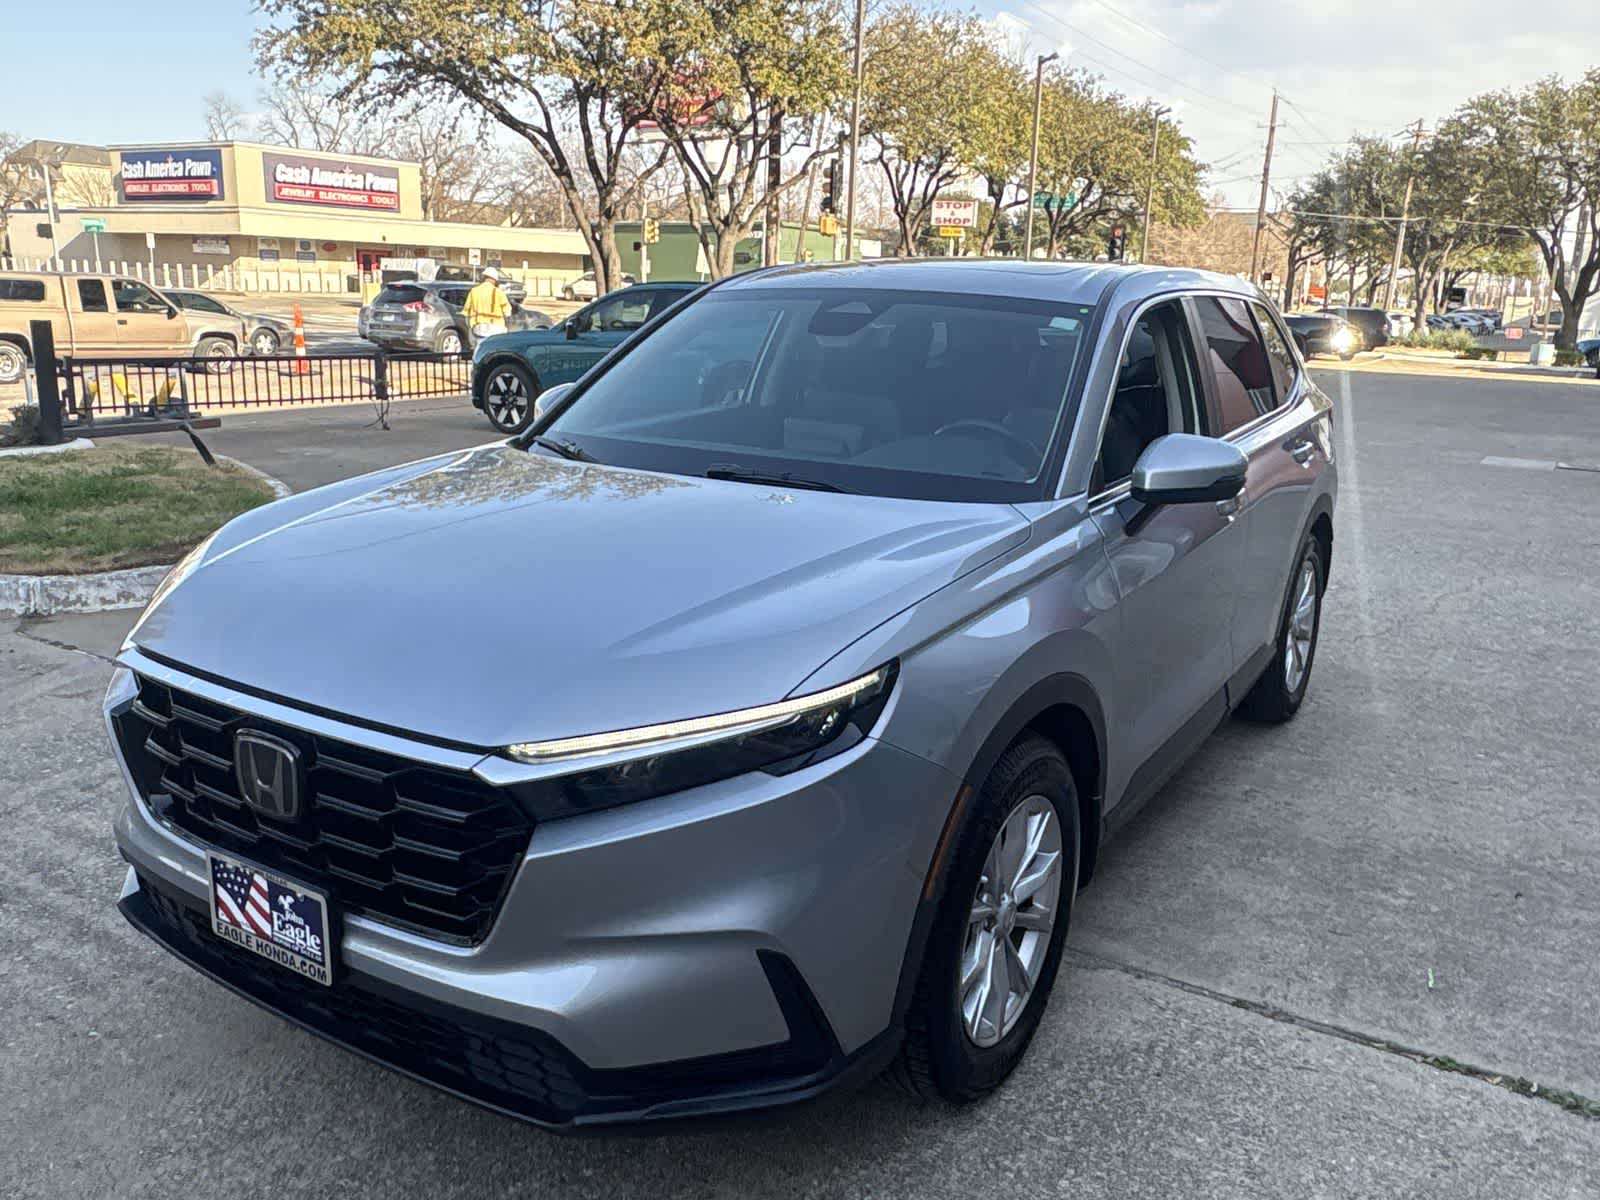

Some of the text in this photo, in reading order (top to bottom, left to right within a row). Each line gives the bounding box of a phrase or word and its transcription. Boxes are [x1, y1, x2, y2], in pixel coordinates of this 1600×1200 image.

[121, 158, 212, 178] Cash America Pawn
[275, 163, 398, 192] Cash America Pawn
[280, 187, 395, 205] JEWELRY ELECTRONICS TOOLS
[935, 201, 972, 209] STOP
[934, 217, 971, 225] SHOP
[284, 908, 304, 925] John
[271, 910, 321, 950] Eagle
[216, 921, 253, 949] EAGLE
[255, 938, 327, 983] HONDA.COM
